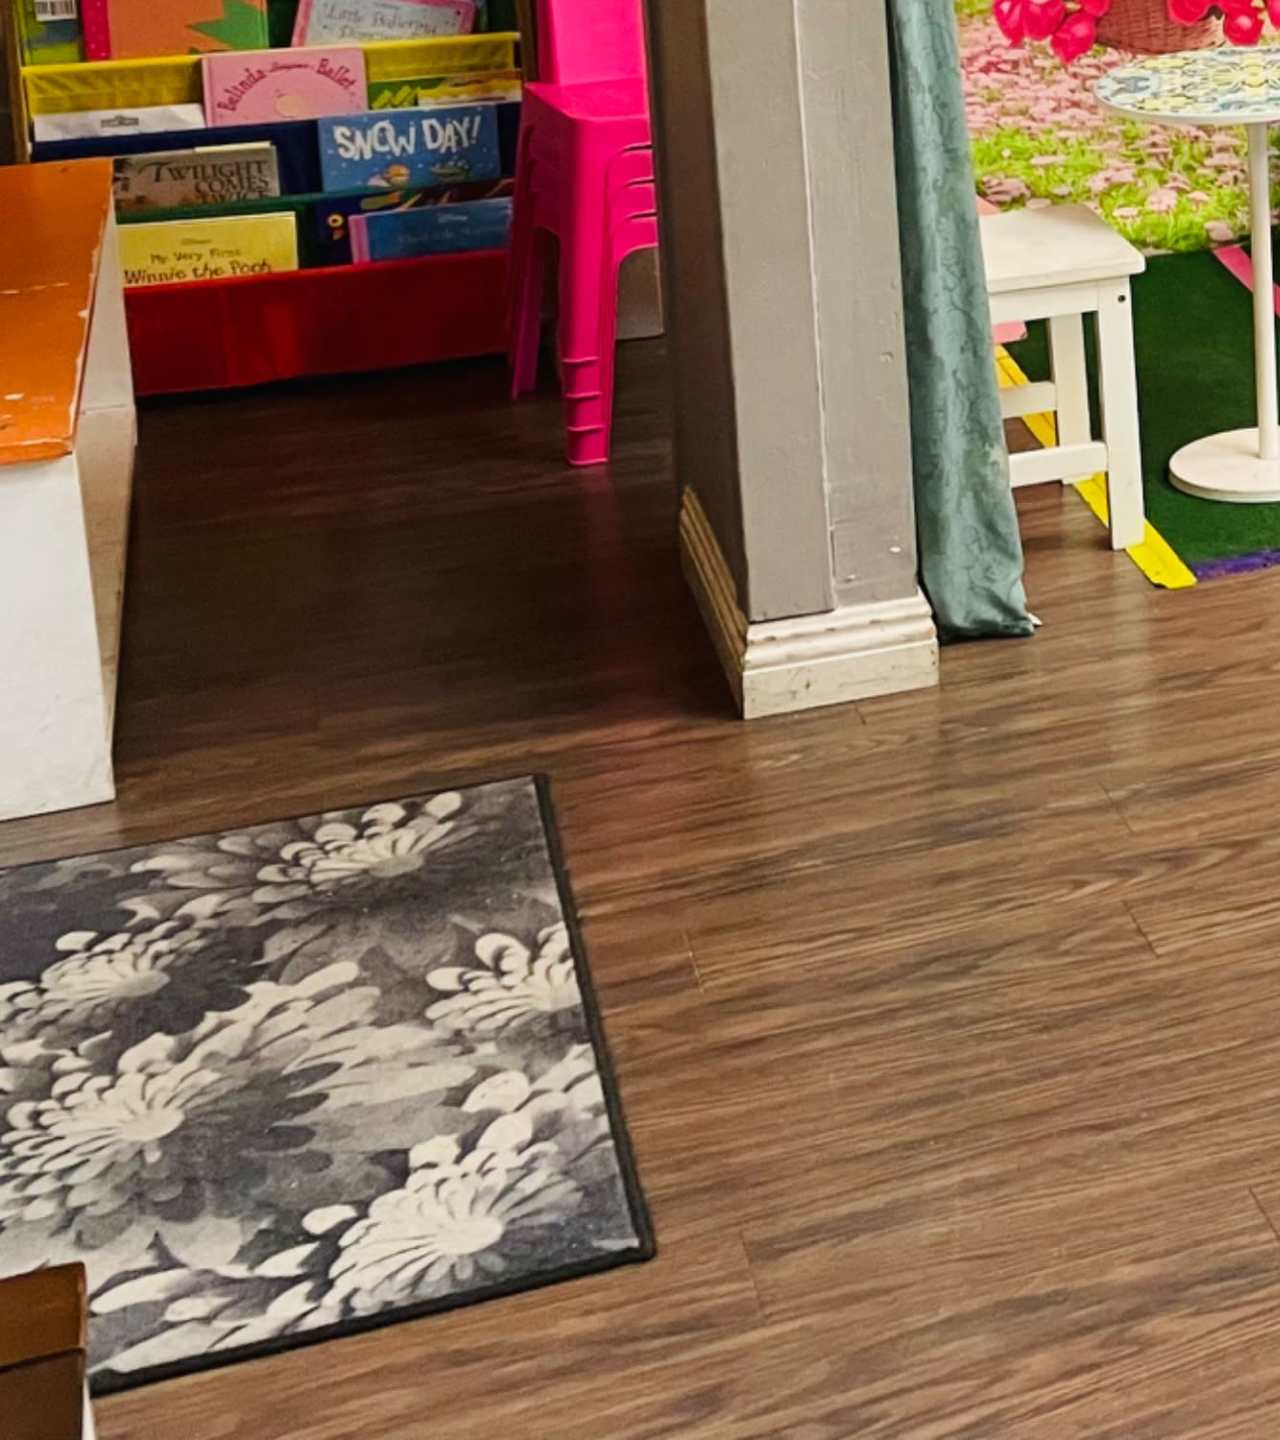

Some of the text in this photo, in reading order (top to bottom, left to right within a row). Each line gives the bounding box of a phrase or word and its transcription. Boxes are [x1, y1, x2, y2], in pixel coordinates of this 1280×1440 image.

[216, 58, 358, 111] Belinda Ballet
[332, 115, 482, 161] SNOW DAY!
[137, 160, 267, 183] TWILIGHT
[194, 176, 270, 194] COMES
[123, 259, 272, 285] Winnie the Pooh
